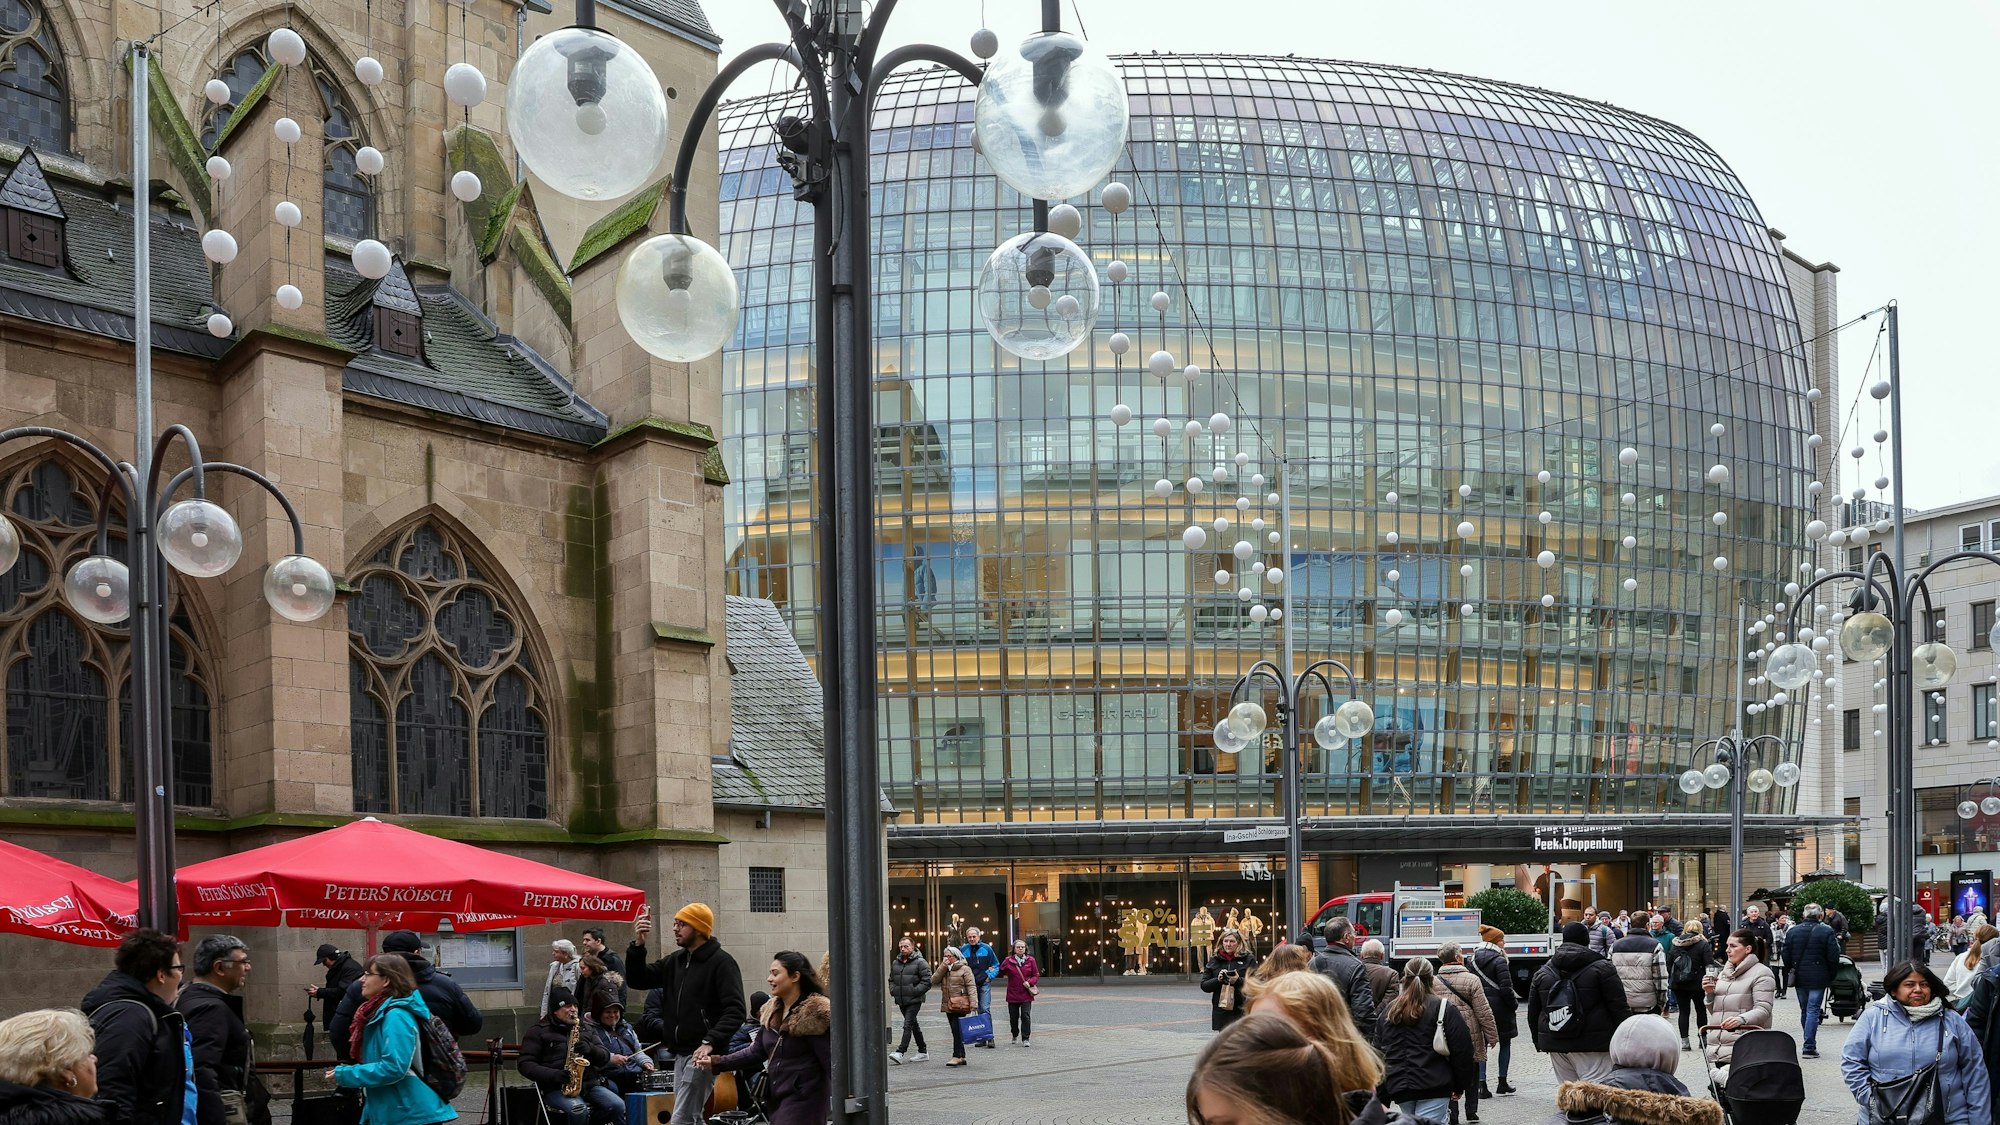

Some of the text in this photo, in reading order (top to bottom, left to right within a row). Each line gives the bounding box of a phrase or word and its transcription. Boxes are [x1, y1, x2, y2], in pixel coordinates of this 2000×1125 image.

[1258, 827, 1287, 836] Schildergasse
[198, 883, 267, 901] PETERS KÖLSCH
[325, 884, 453, 903] PETERS KÖLSCH
[523, 891, 632, 911] PETERS KÖLSCH
[1122, 908, 1177, 924] 50%
[1118, 925, 1211, 948] SALE
[1548, 1005, 1570, 1024] NIKE
